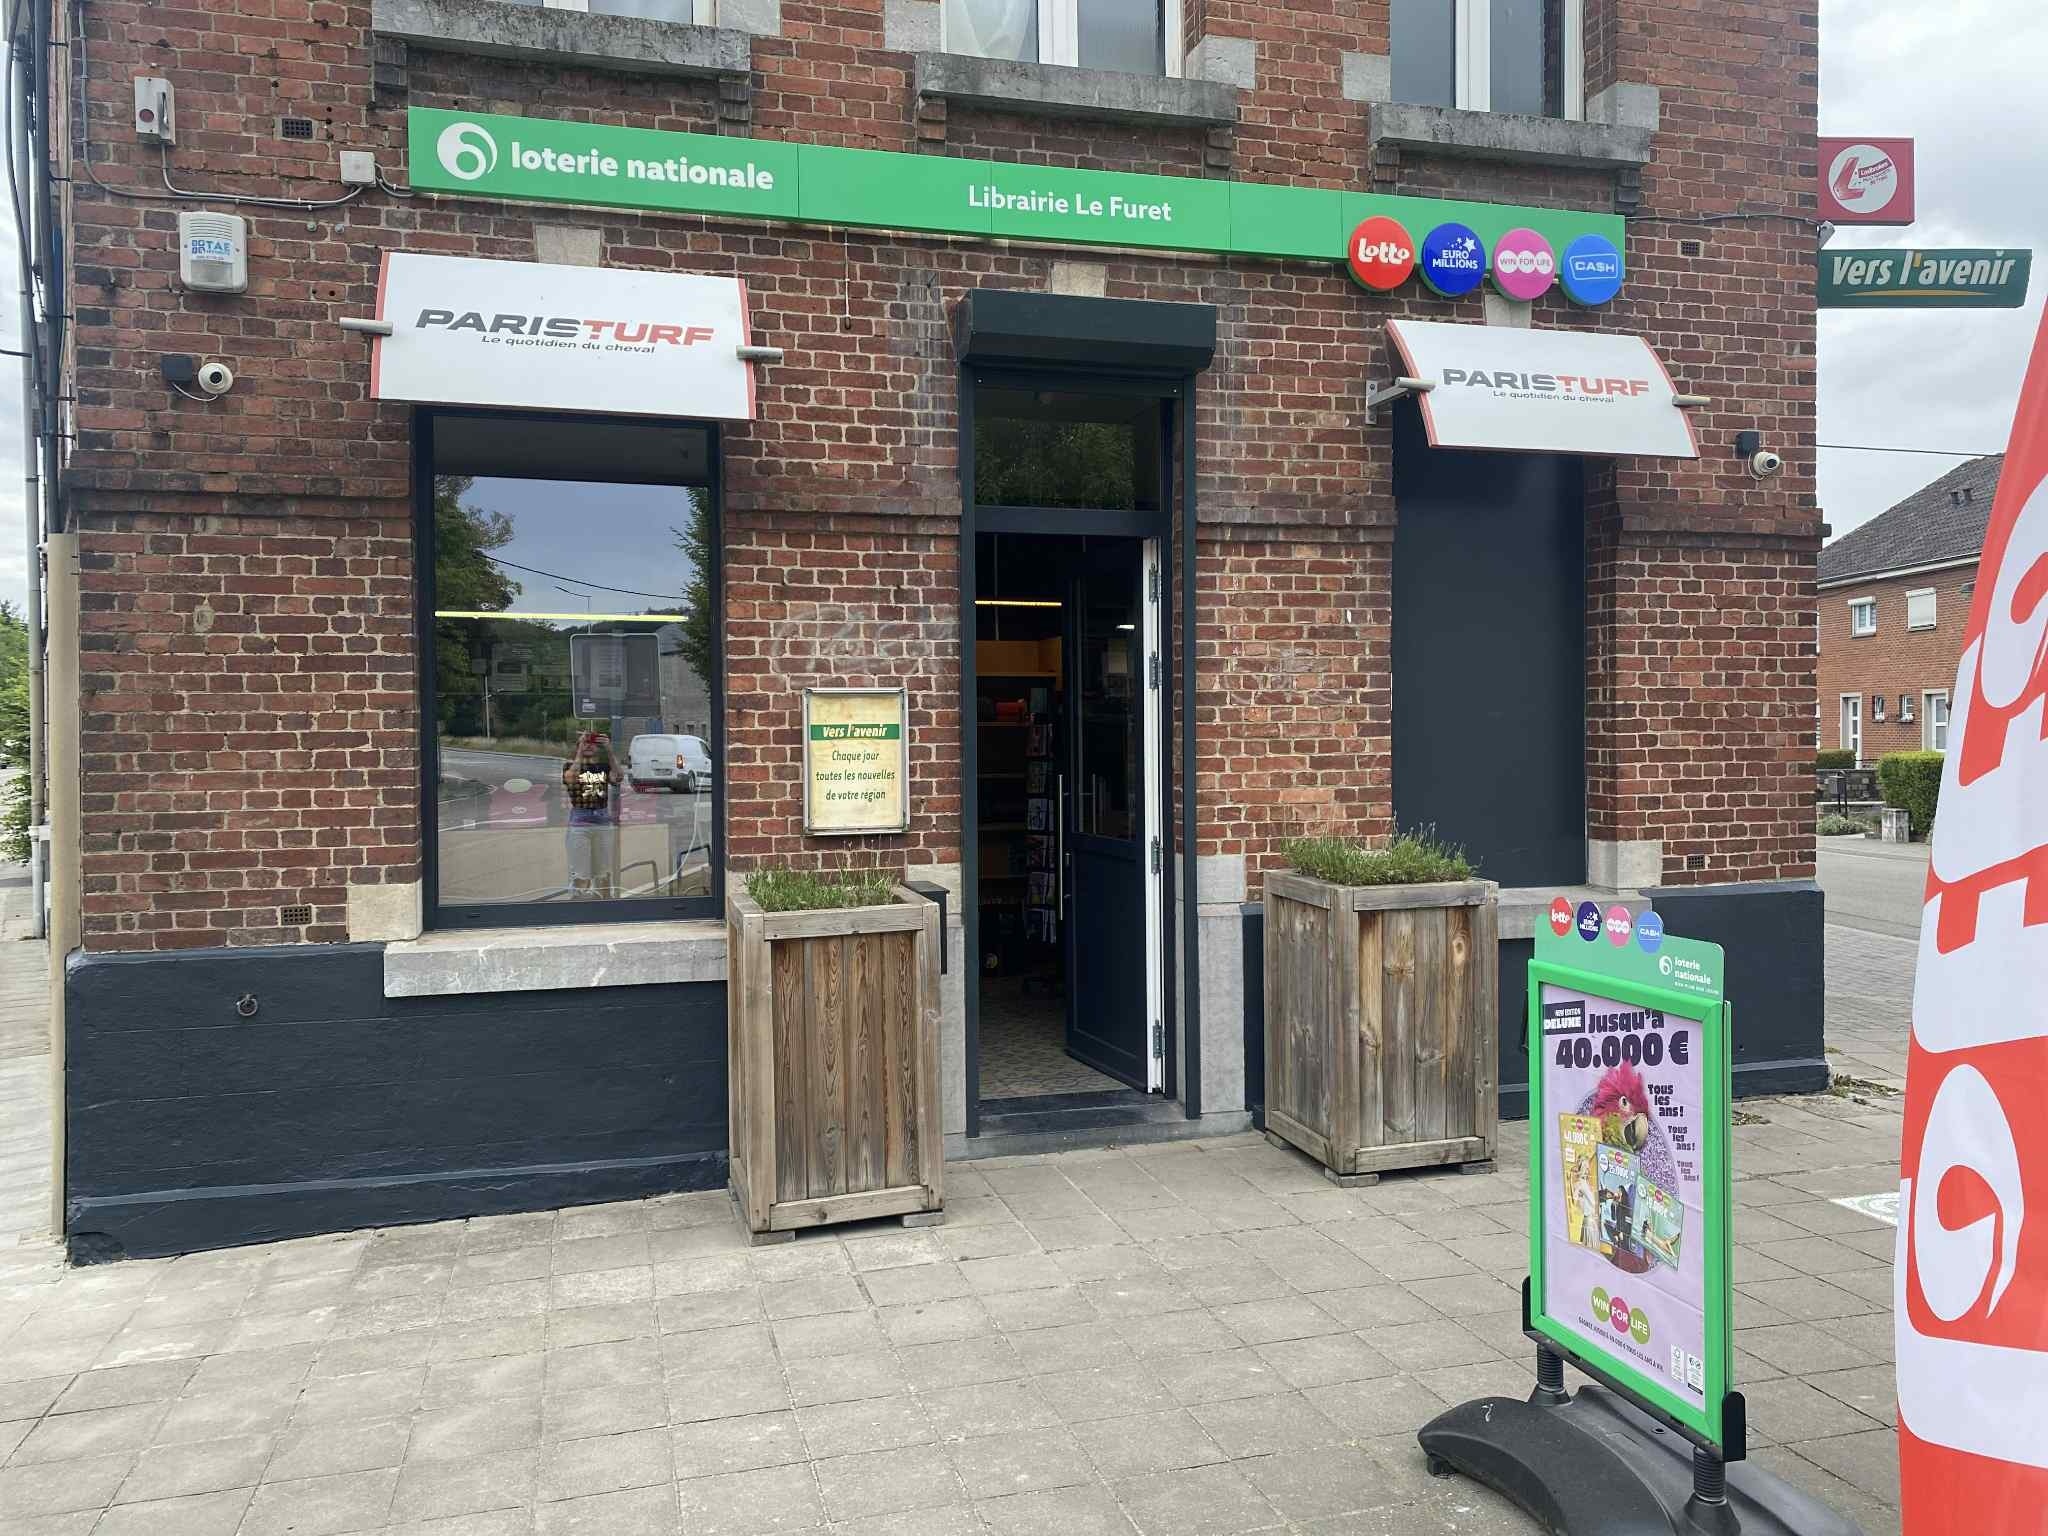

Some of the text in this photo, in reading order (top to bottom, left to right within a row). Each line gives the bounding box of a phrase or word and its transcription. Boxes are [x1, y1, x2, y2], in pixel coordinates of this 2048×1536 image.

[510, 140, 775, 191] loterie nationale
[968, 183, 1173, 222] Librairie Le Furet
[1442, 248, 1470, 260] EURO
[1500, 257, 1552, 267] WIN FOR LIFE
[1432, 258, 1479, 271] MILLIONS
[1574, 260, 1616, 273] CASH
[1831, 249, 2017, 286] Vers l'avenir
[415, 307, 716, 347] PARISTURF
[481, 334, 656, 355] Le quotidien du cheval
[1442, 367, 1649, 397] PARISTURF
[1492, 389, 1616, 404] Le quotidien du cheval
[822, 722, 888, 738] Vers l'avenir
[831, 749, 881, 765] Chaque jour
[815, 768, 896, 782] toutes les nouvelles
[825, 788, 886, 803] de votre région
[1674, 955, 1701, 971] loterie
[1674, 970, 1711, 985] nationale
[1555, 1030, 1689, 1069] 40.000 €
[1647, 1083, 1674, 1096] Tous
[1654, 1095, 1671, 1106] les
[1592, 1295, 1649, 1336] WIN FOR LIFE
